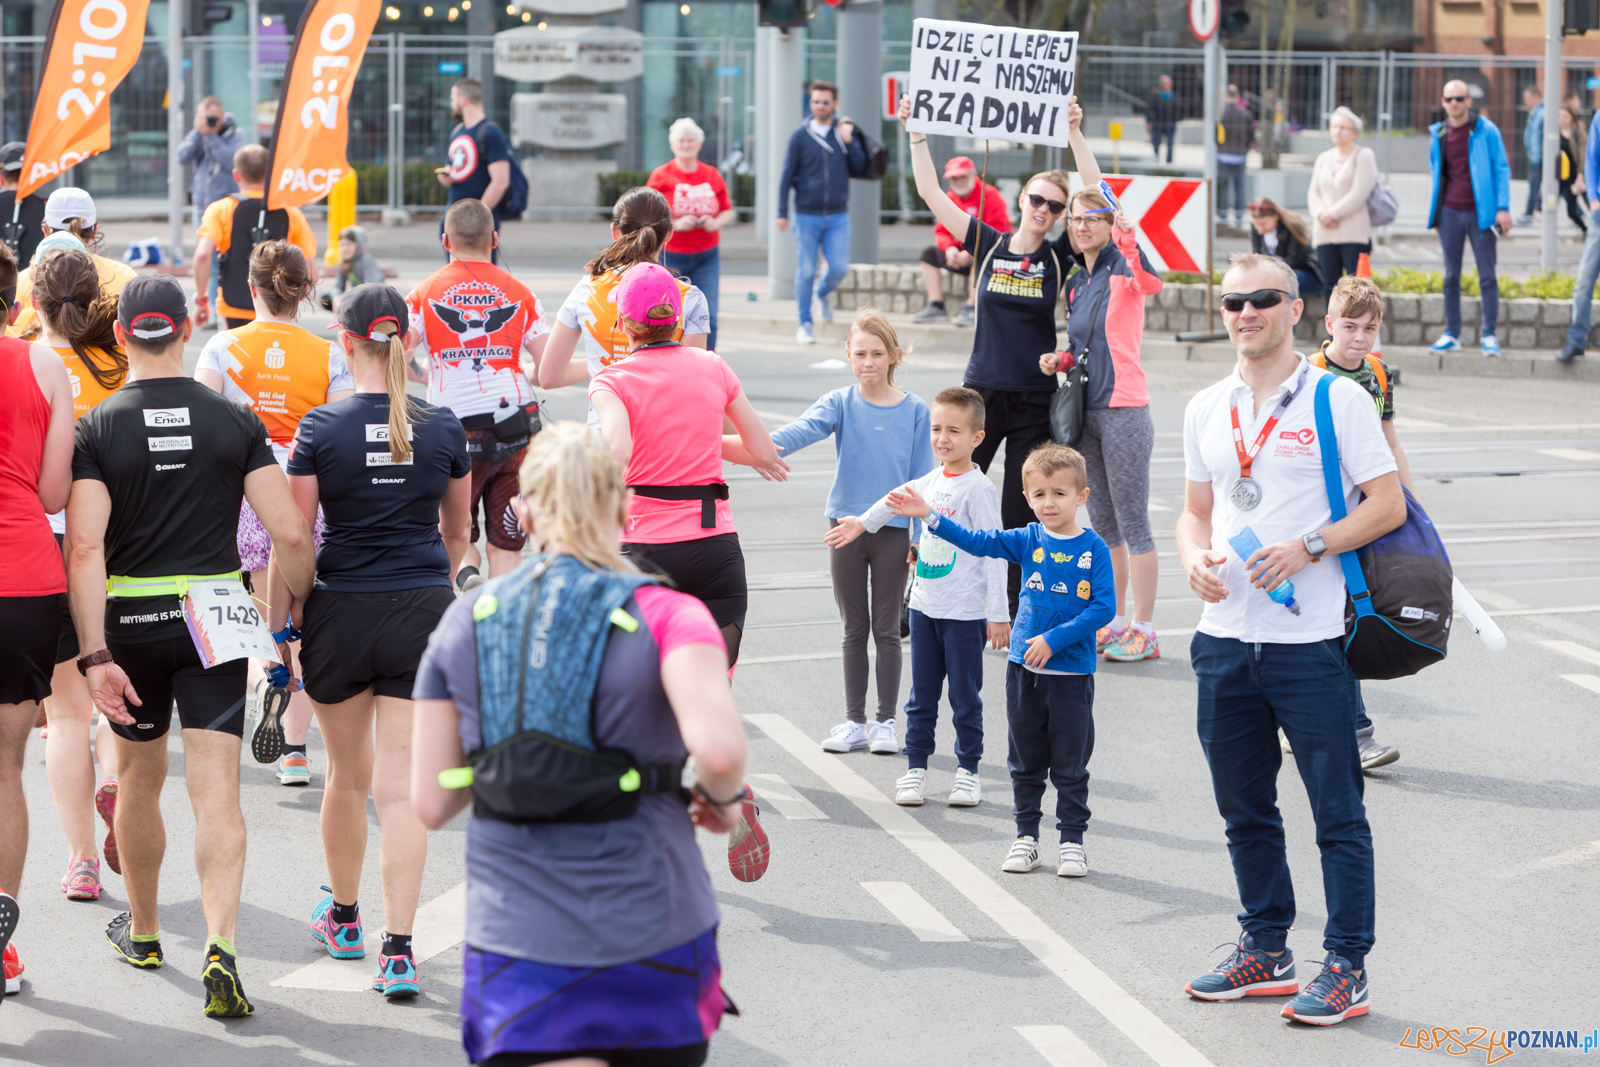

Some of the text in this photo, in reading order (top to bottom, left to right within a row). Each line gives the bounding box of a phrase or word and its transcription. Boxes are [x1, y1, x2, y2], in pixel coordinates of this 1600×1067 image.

[1009, 32, 1074, 63] LEPIEJ
[300, 12, 356, 130] 2:10
[931, 55, 1074, 96] NIŻ NASZEMU
[912, 89, 1060, 137] RZĄDOWI
[986, 281, 1044, 298] FINISHER
[452, 294, 497, 305] PKMF
[441, 348, 512, 360] KRAV MAGA
[256, 372, 291, 382] Bank Polski
[258, 391, 271, 399] Mój
[260, 405, 288, 414] Poznaniu
[154, 416, 185, 424] Enea
[1276, 444, 1311, 452] CHALLENGE
[119, 613, 159, 624] ANYTHING
[159, 611, 169, 621] IS
[169, 609, 184, 619] PO
[209, 605, 260, 627] 7429
